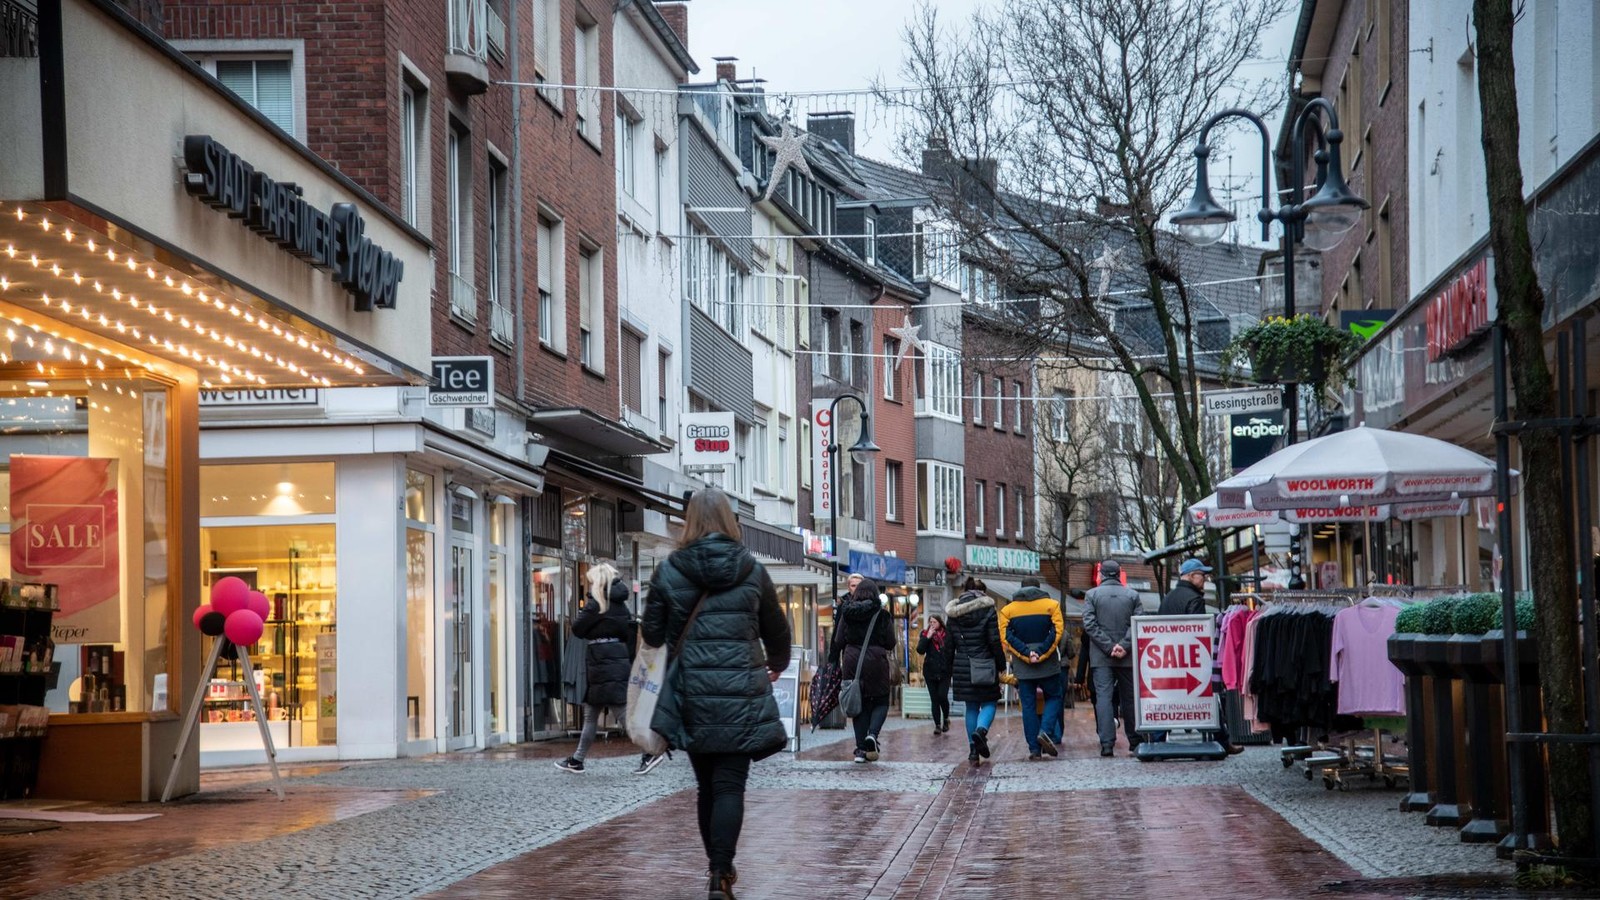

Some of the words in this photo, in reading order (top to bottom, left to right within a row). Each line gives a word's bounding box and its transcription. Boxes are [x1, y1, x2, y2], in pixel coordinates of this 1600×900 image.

[435, 363, 481, 389] Tee
[432, 393, 486, 402] Gschwendner
[1209, 393, 1279, 410] Lessingstraße
[687, 424, 730, 438] Game
[1233, 423, 1284, 438] engber
[695, 438, 730, 453] Stop
[821, 430, 830, 509] vodafone
[1287, 478, 1374, 492] WOOLWORTH
[1404, 475, 1482, 487] WWW.WOOLWORTH.DE
[31, 523, 100, 549] SALE
[971, 547, 998, 567] MODE
[1142, 624, 1204, 634] WOOLWORTH
[1146, 644, 1202, 669] SALE
[1145, 703, 1166, 711] JETZT
[1168, 703, 1211, 711] KNALLHART
[1145, 711, 1211, 721] REDUZIERT!
